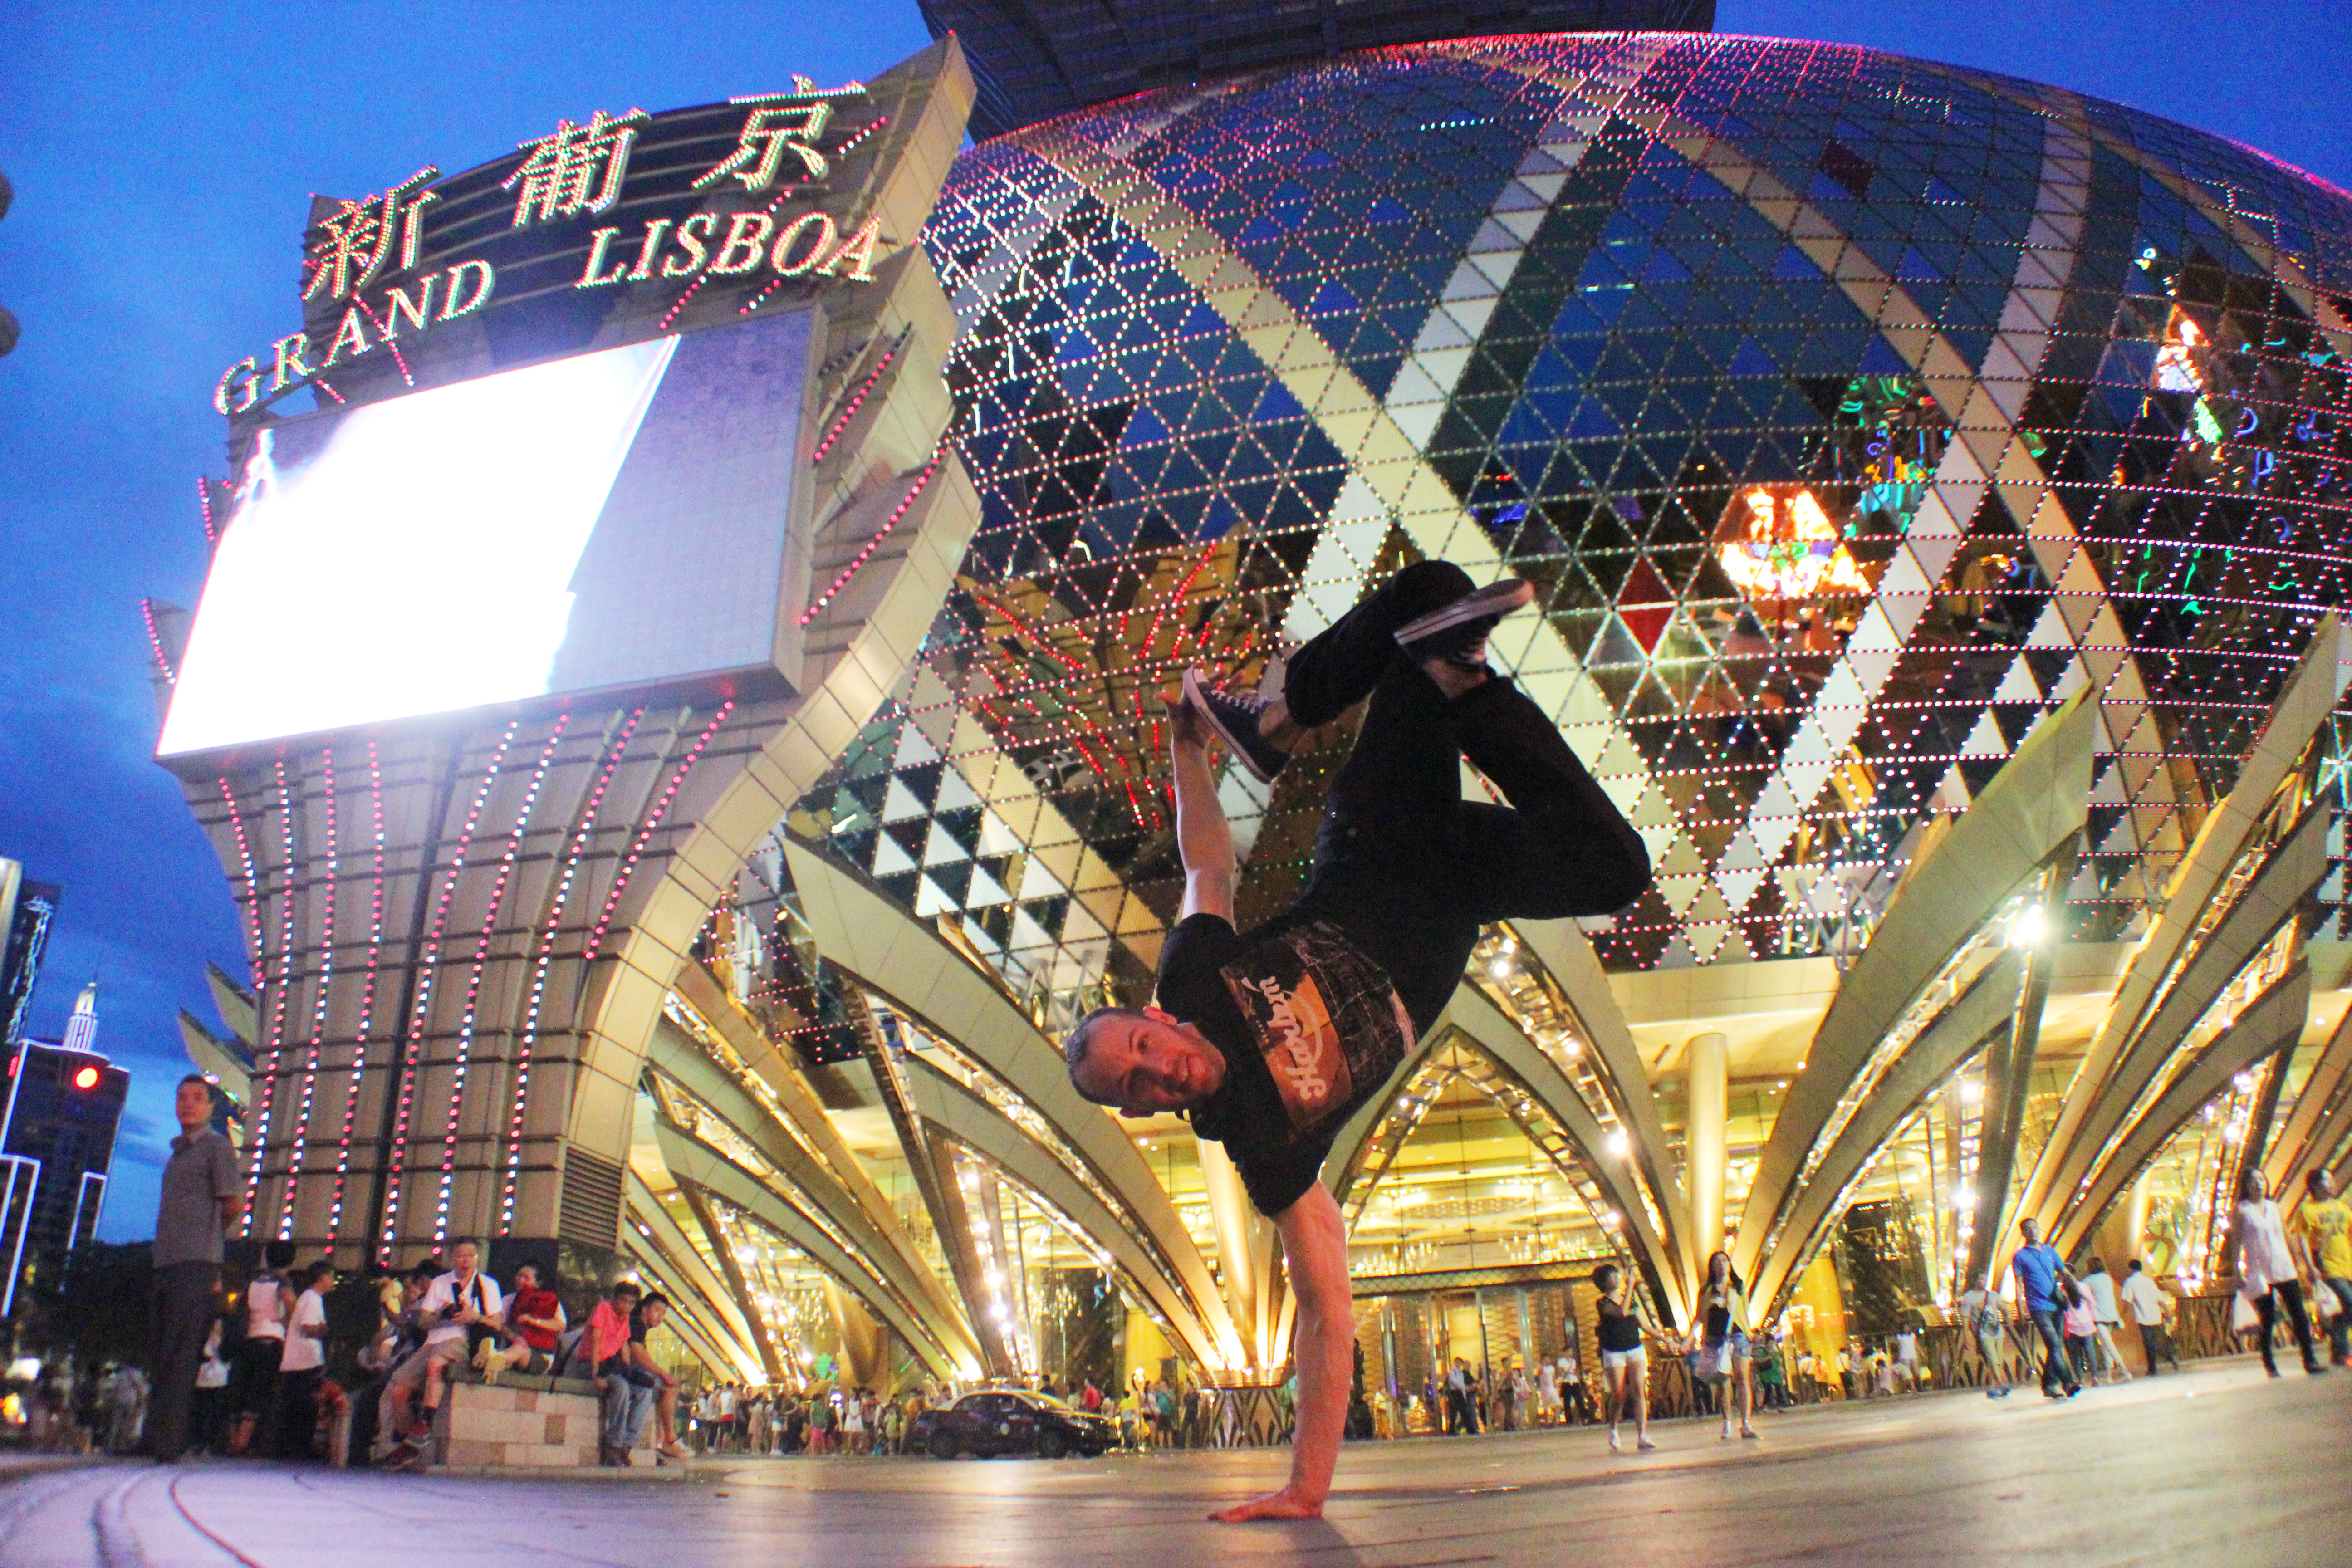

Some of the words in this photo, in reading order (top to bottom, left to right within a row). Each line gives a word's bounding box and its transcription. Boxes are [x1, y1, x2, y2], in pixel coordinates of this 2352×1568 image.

[301, 74, 868, 299] 新葡京
[213, 259, 495, 416] GRAND
[574, 211, 882, 289] LISBOA
[1259, 975, 1328, 1100] Harlem
